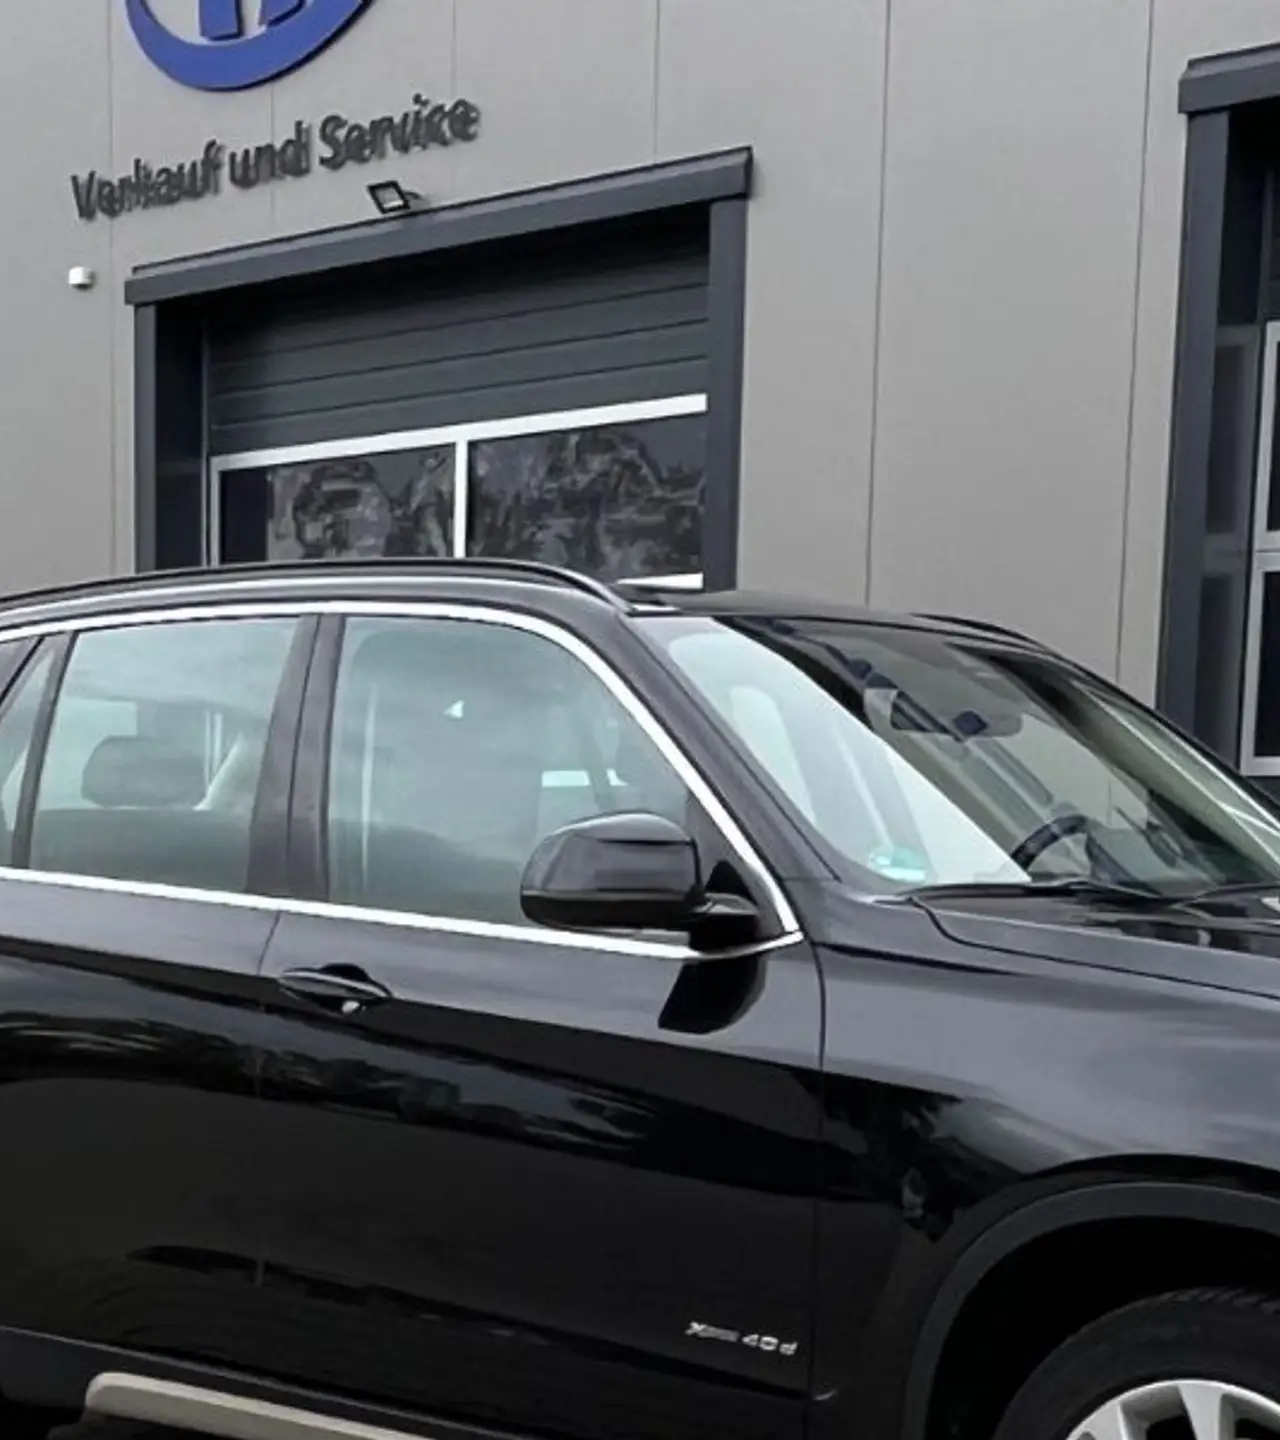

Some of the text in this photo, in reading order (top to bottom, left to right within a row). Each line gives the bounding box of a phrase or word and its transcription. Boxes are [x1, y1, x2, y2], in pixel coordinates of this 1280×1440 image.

[71, 93, 482, 221] Verkauf und Service
